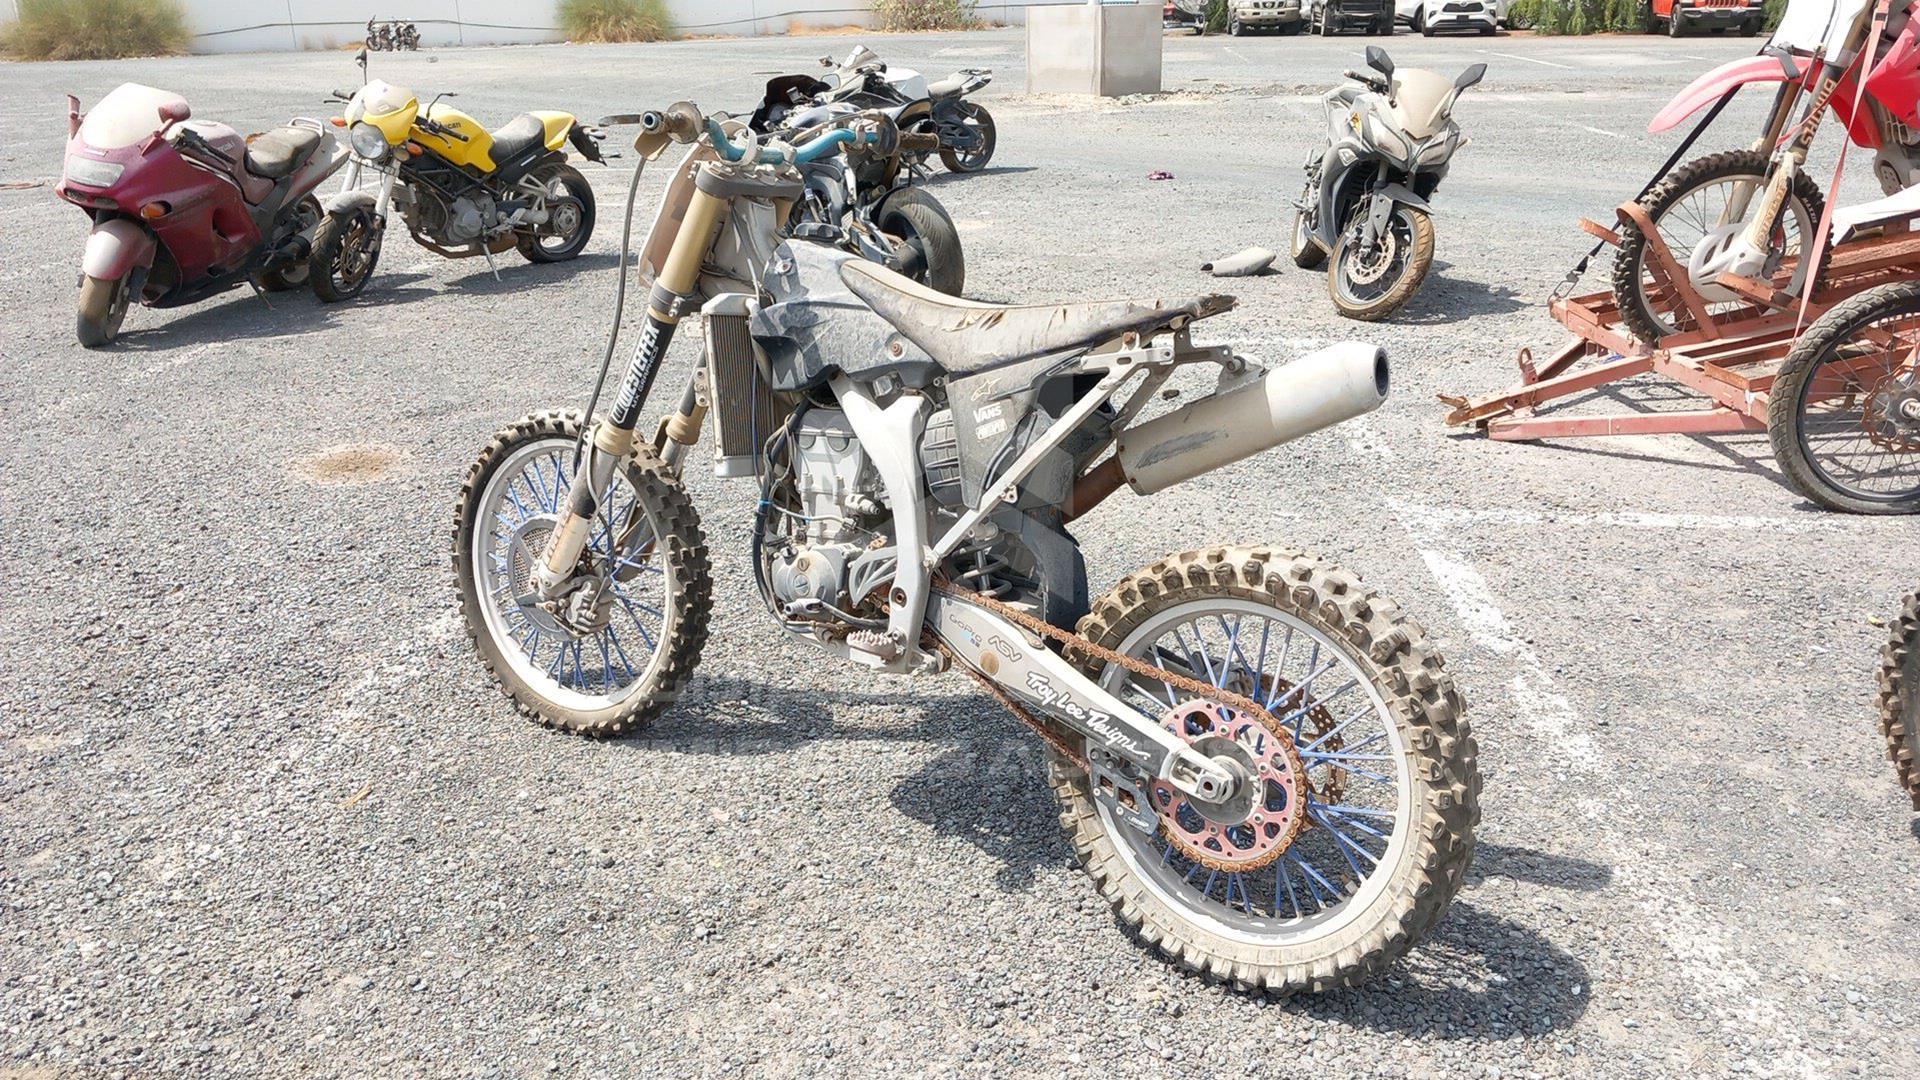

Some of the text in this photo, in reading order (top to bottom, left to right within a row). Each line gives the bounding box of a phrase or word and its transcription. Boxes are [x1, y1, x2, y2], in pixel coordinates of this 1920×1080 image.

[638, 345, 660, 393] GRAPHICS
[973, 402, 1002, 423] VANS
[948, 614, 983, 643] GoPro
[988, 634, 1022, 662] ASV
[1027, 672, 1058, 705] Troy
[1056, 692, 1087, 719] Lee
[1087, 709, 1151, 760] Designs
